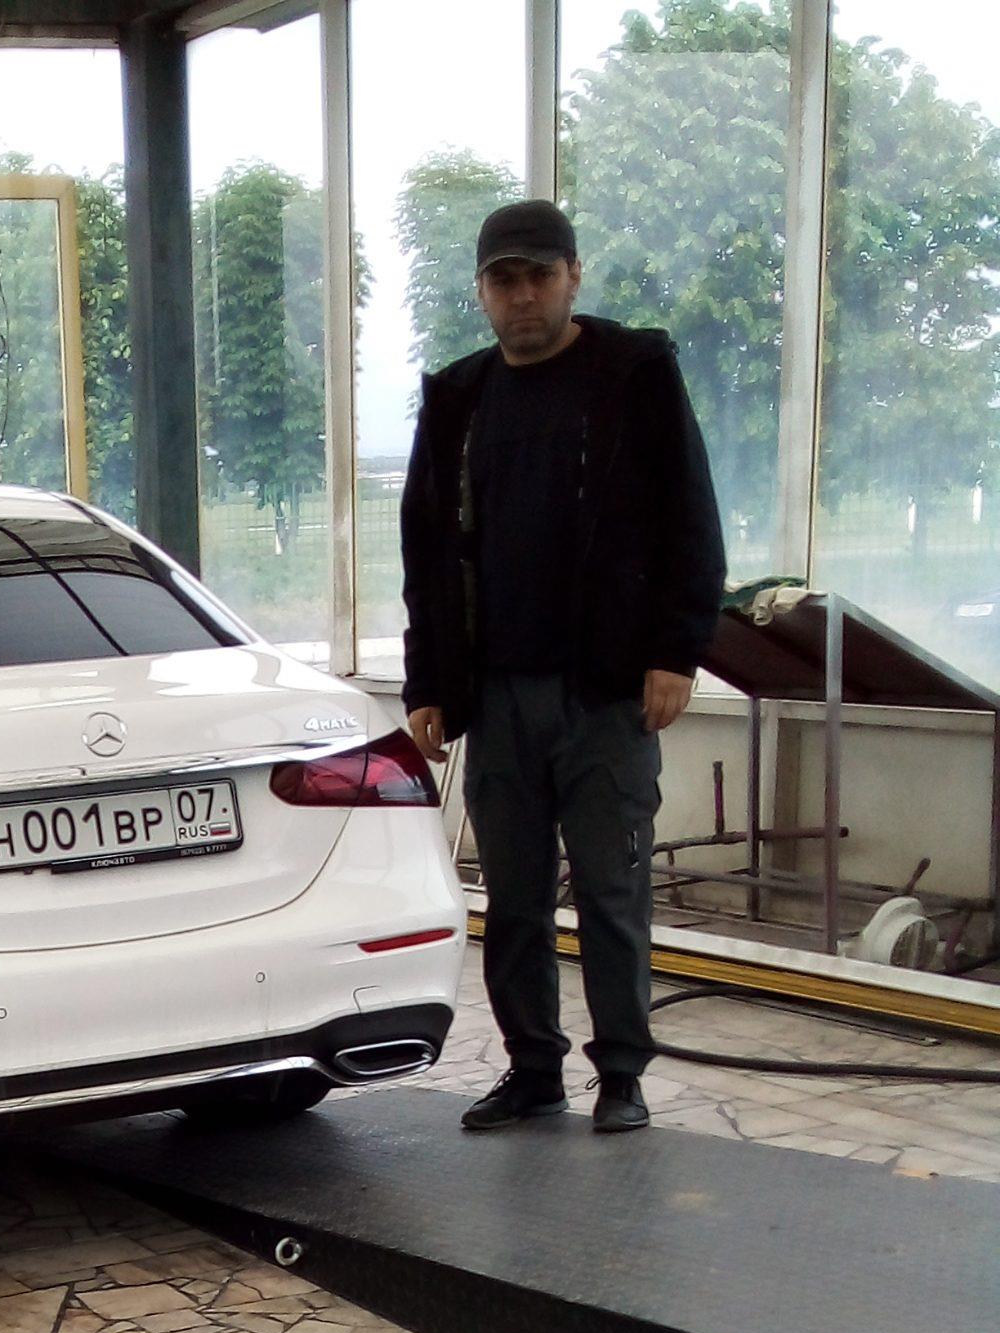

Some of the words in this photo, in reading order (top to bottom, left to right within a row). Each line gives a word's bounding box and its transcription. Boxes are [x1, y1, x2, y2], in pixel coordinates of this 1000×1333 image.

[304, 717, 359, 732] 4MATIC
[177, 788, 214, 823] 07
[178, 826, 209, 839] RUS
